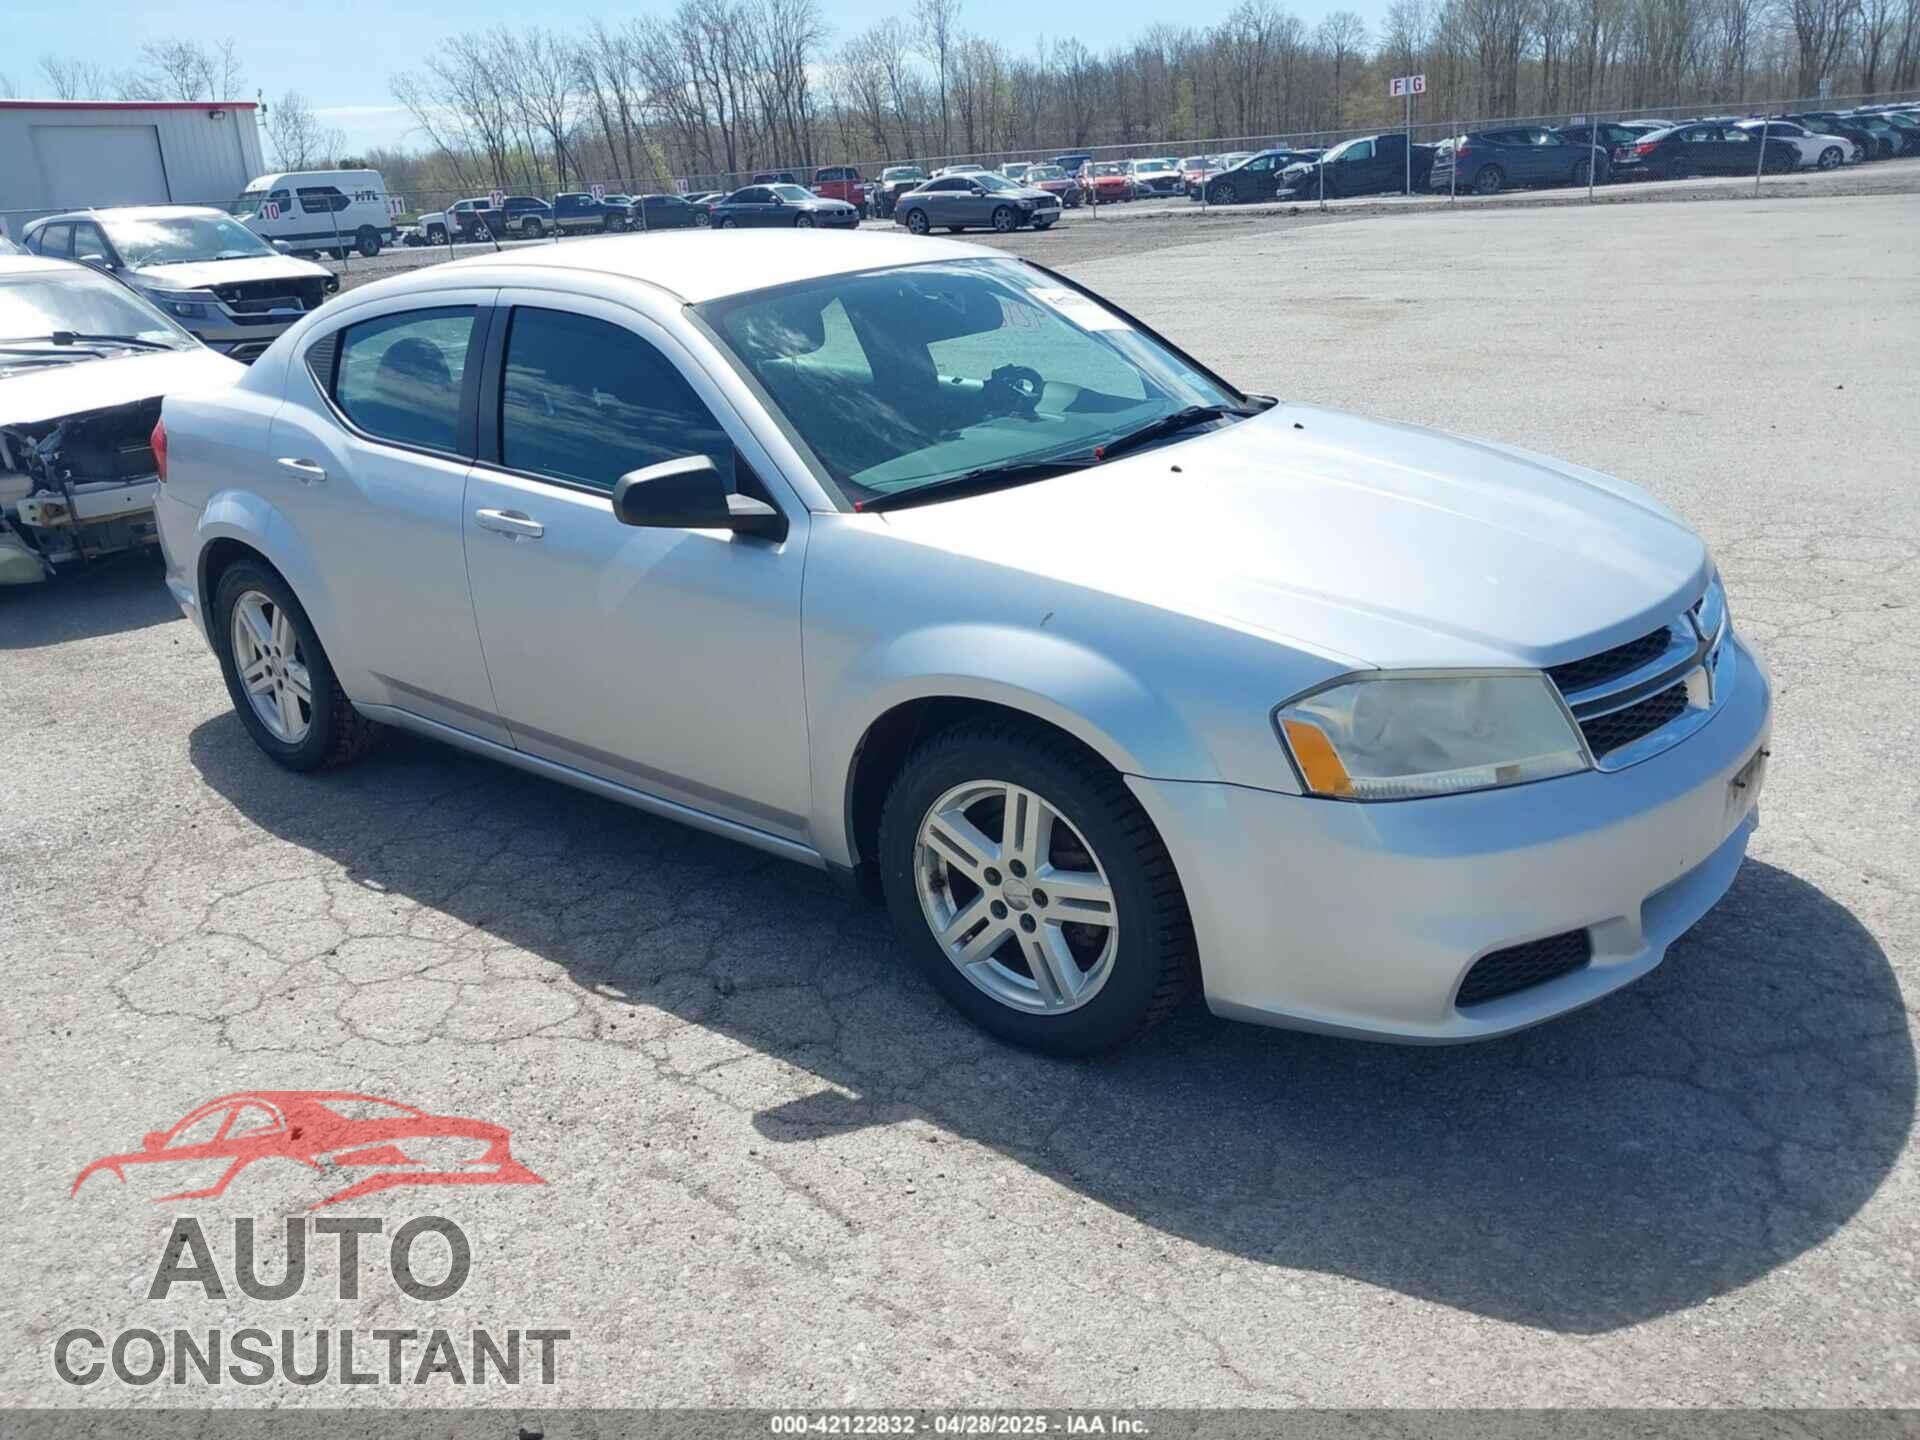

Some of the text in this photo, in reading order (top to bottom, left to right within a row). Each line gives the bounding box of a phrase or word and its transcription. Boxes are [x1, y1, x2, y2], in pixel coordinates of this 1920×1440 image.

[1394, 77, 1422, 94] F G
[391, 198, 403, 213] 11
[490, 191, 503, 206] 12
[263, 203, 280, 220] 10
